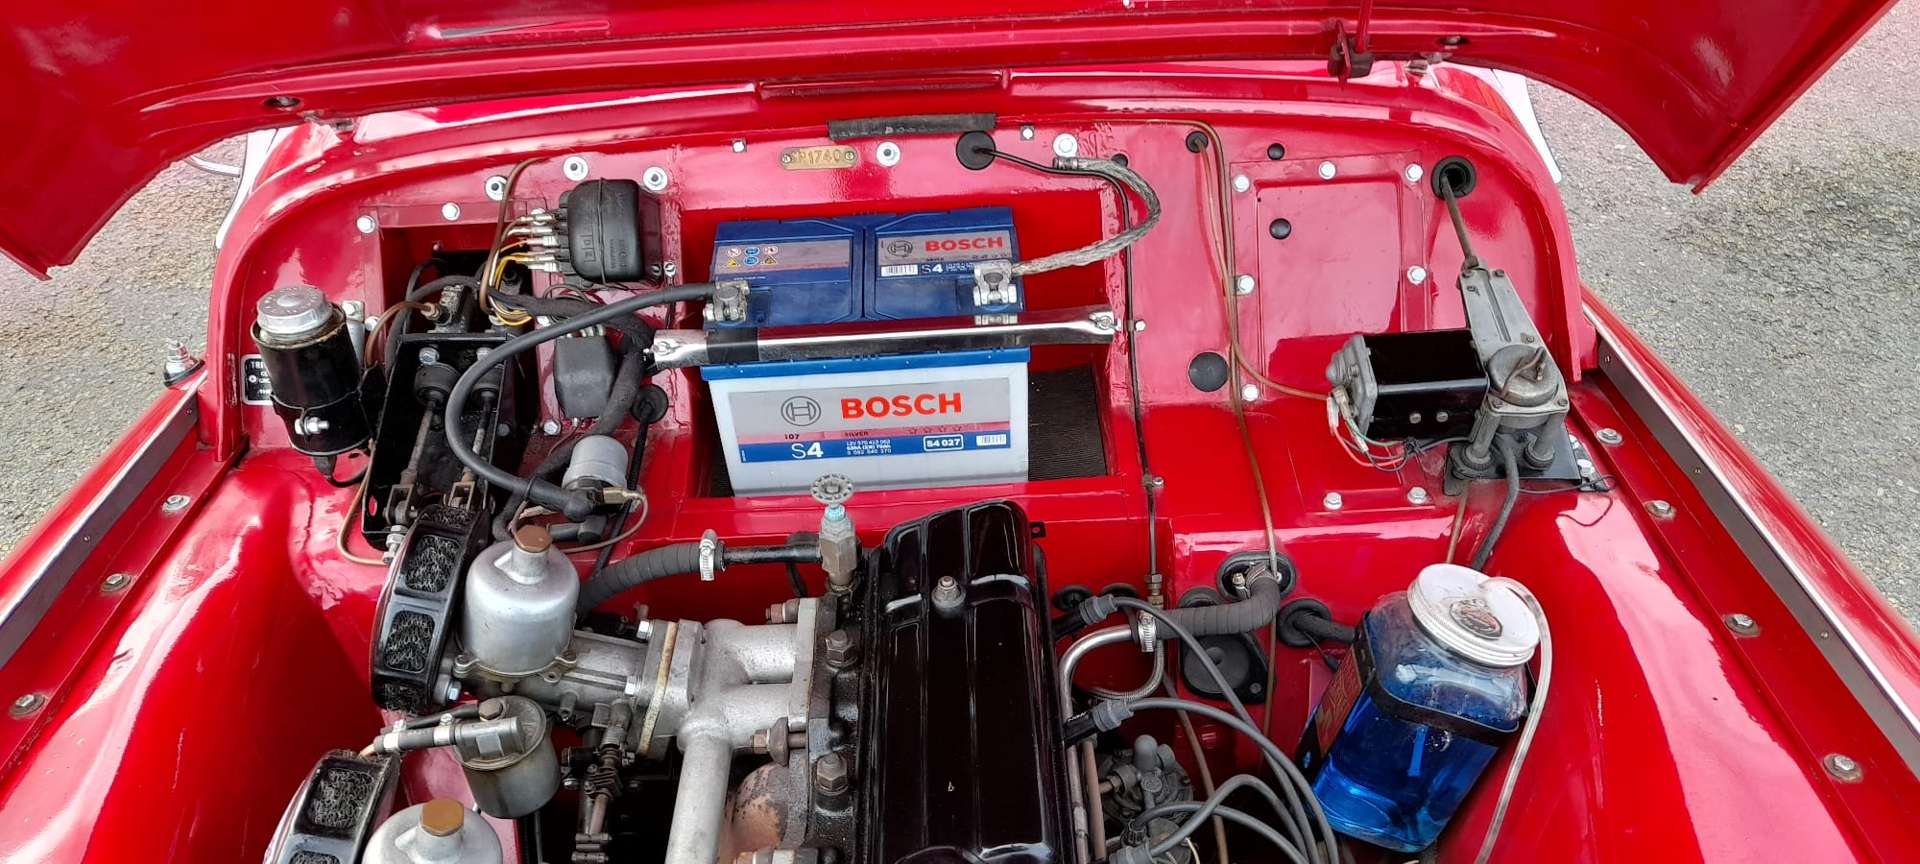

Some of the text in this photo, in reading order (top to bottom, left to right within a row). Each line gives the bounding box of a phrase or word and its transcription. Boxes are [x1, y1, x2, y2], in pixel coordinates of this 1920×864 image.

[925, 236, 1003, 252] BOSCH
[921, 263, 943, 273] S4
[841, 393, 961, 419] BOSCH
[791, 441, 824, 459] S4
[927, 438, 960, 448] S4 027
